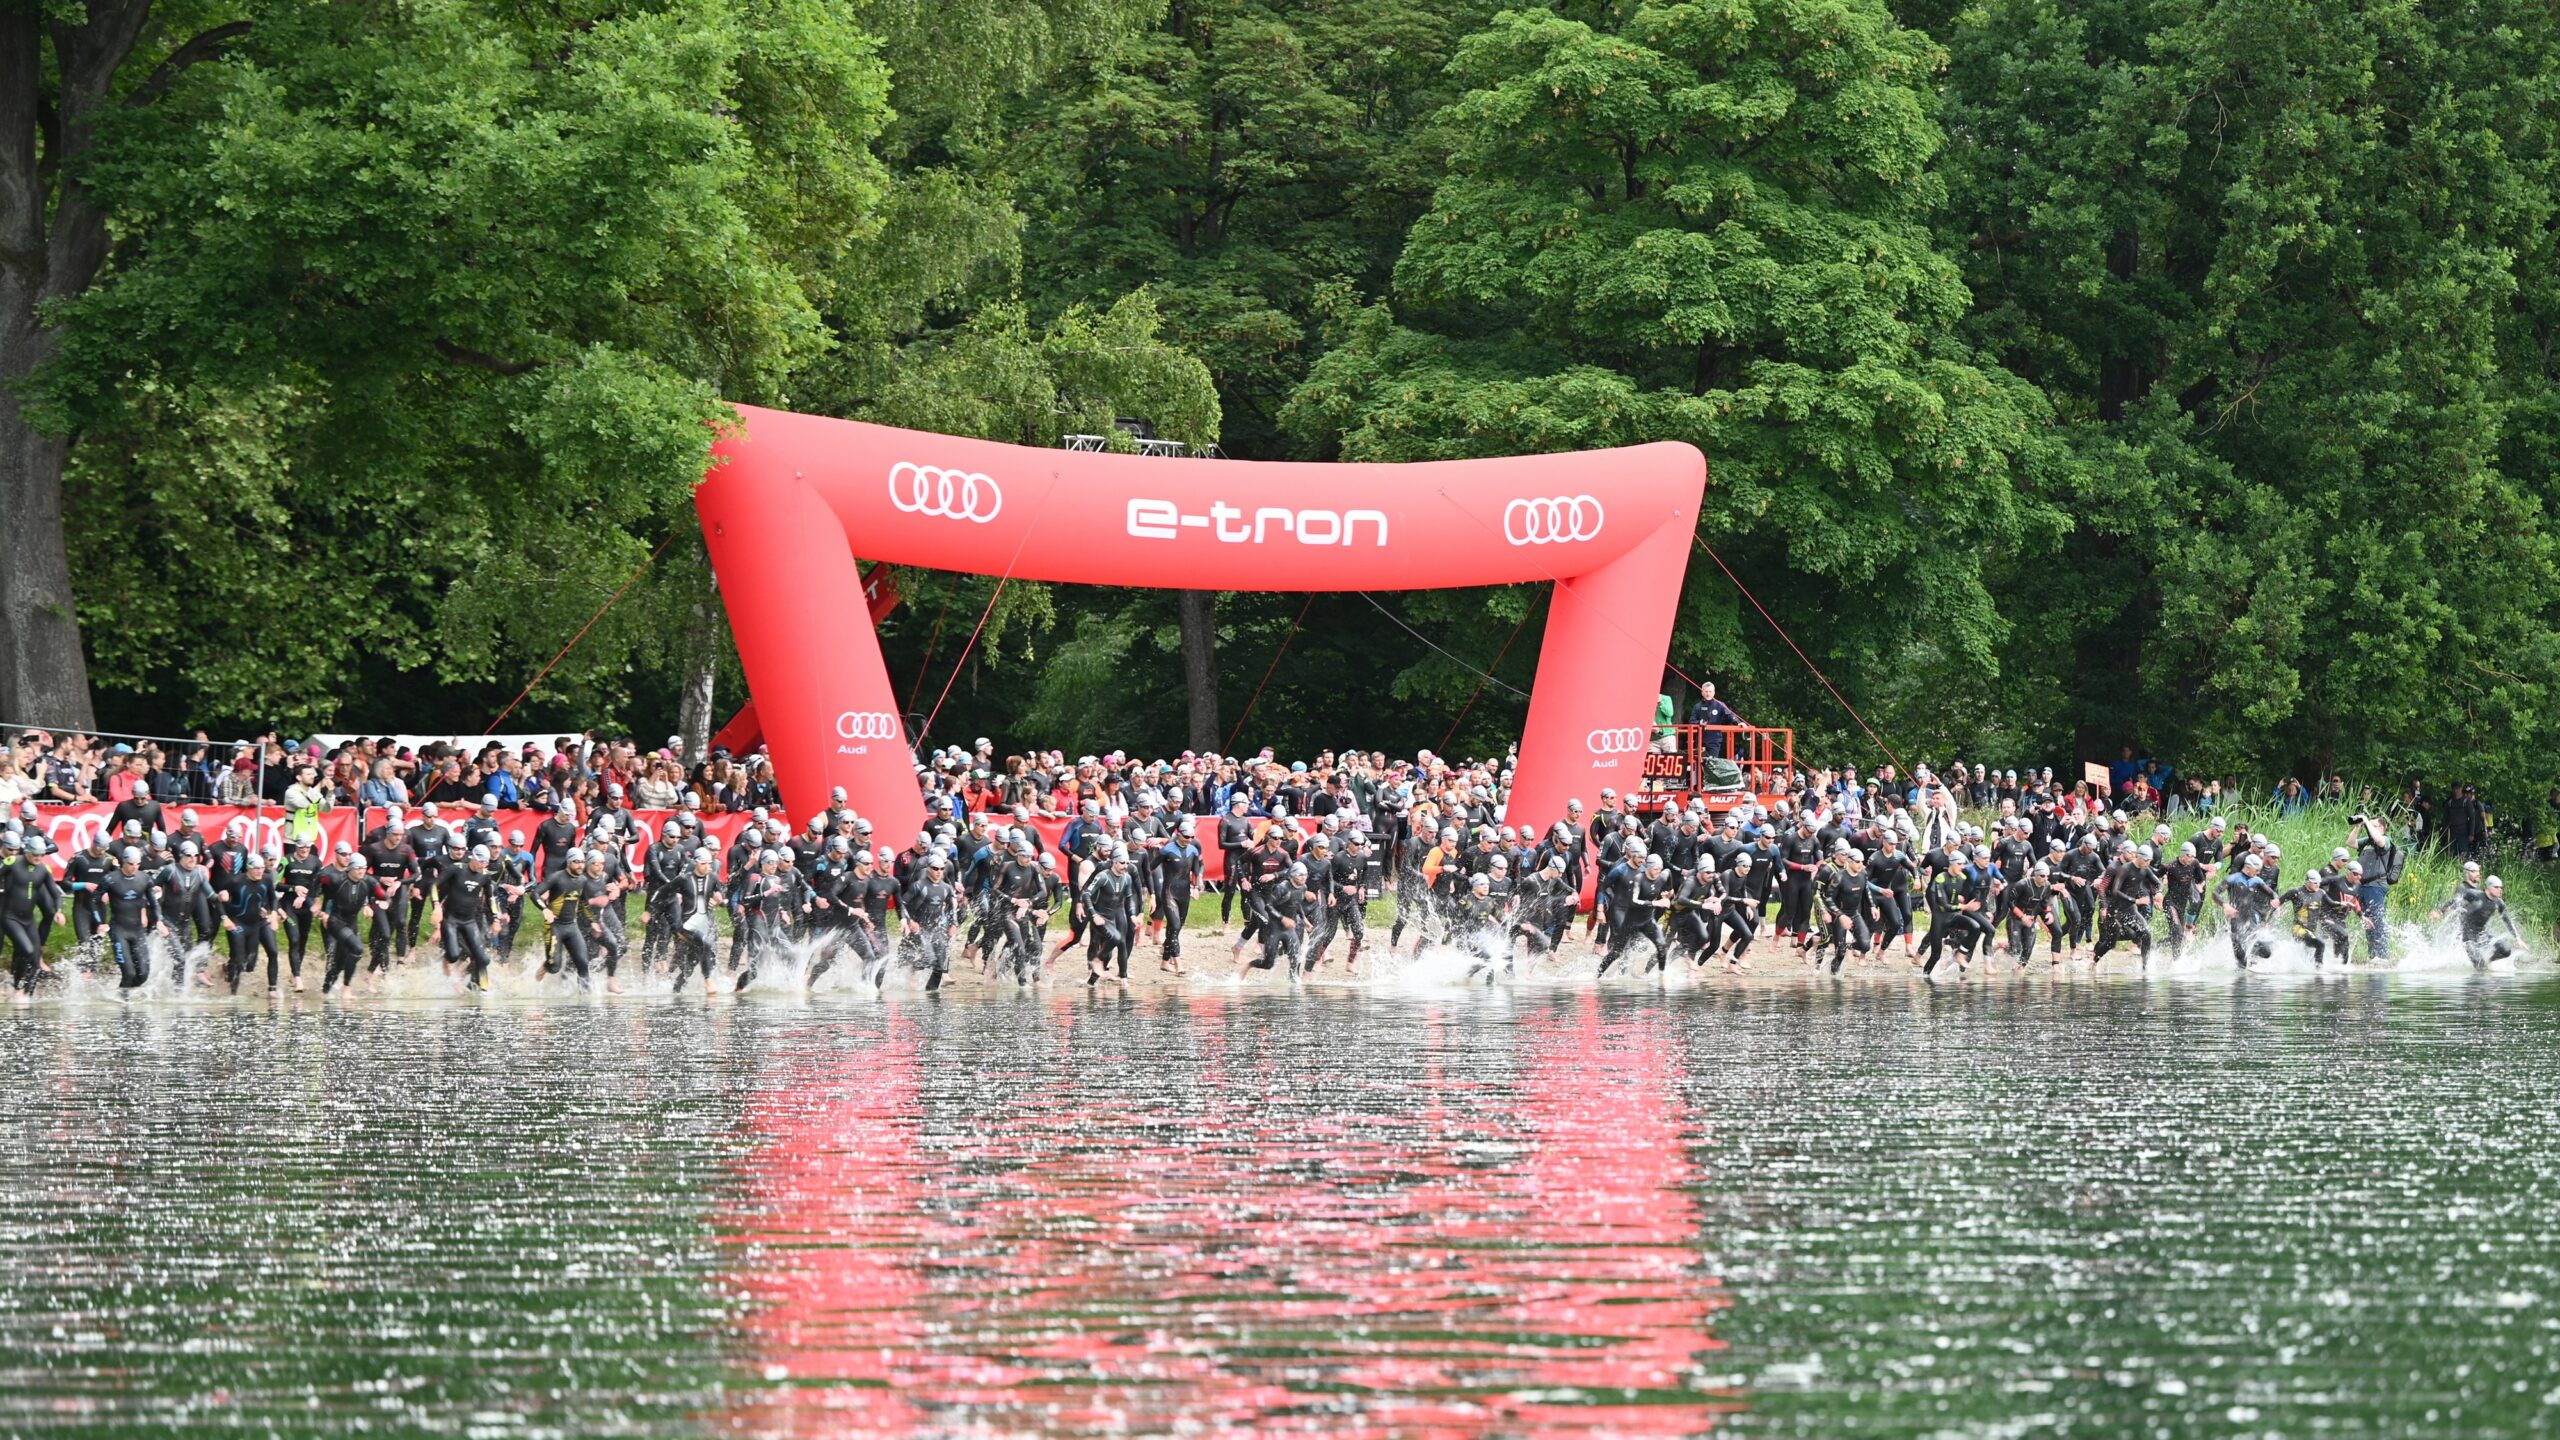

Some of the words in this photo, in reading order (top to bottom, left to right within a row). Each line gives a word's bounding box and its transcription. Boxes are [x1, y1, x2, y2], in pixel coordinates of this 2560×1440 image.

[1126, 498, 1388, 546] e-tron
[837, 744, 867, 754] Audi
[1592, 759, 1618, 769] Audi
[1636, 794, 1677, 804] AULIFT
[1709, 795, 1738, 804] BAULIFT
